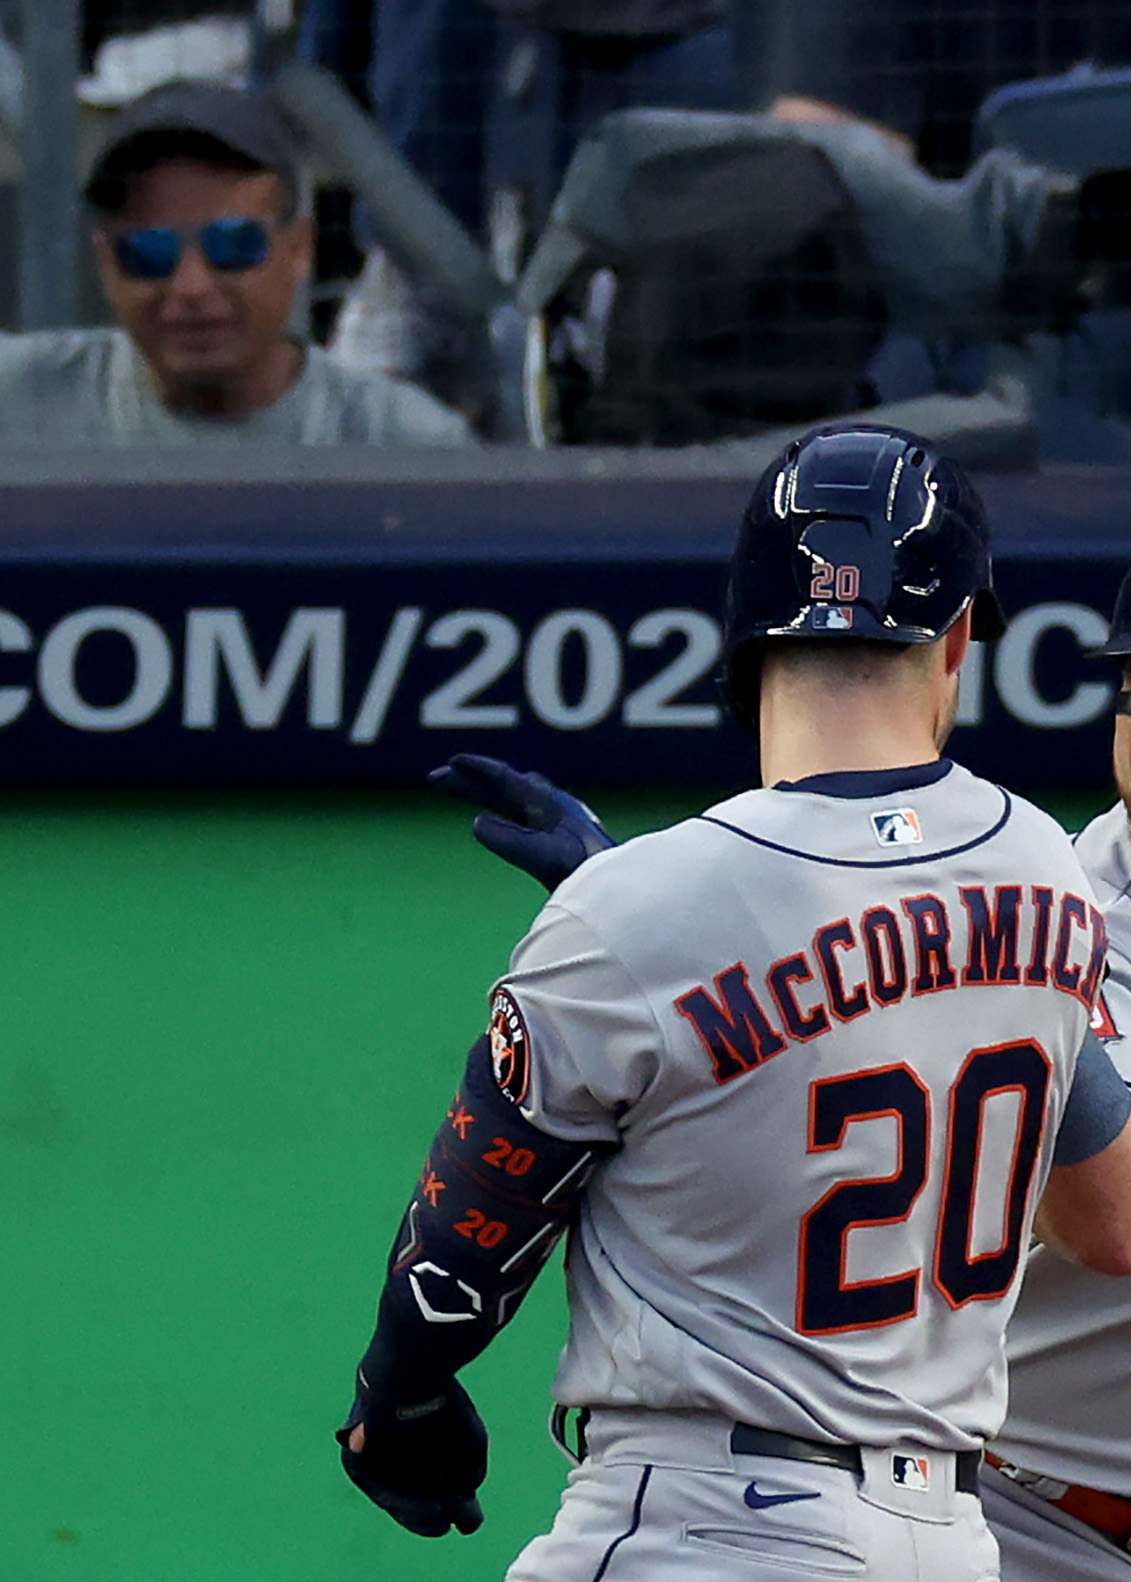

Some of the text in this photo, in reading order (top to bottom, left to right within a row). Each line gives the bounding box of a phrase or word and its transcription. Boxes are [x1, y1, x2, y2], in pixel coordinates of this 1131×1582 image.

[810, 562, 860, 601] 20
[481, 1137, 537, 1177] 20
[796, 1037, 1054, 1337] 20
[453, 1208, 510, 1249] 20
